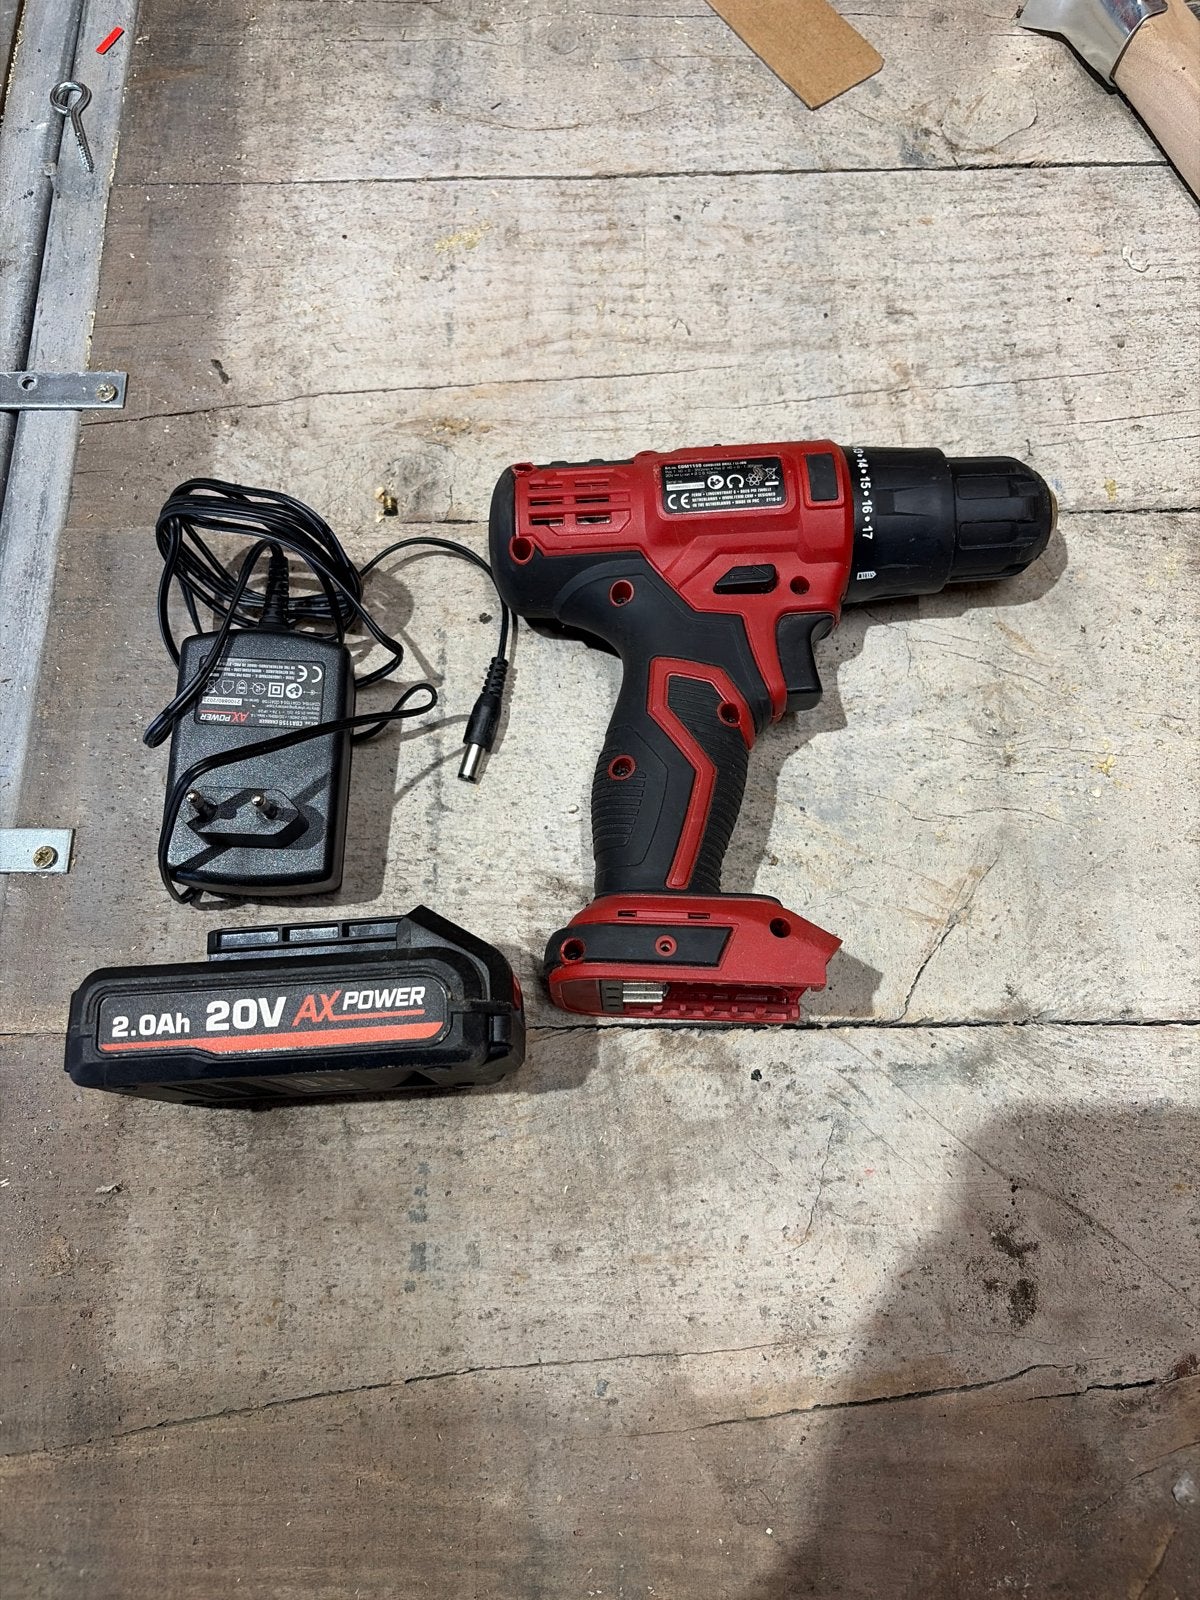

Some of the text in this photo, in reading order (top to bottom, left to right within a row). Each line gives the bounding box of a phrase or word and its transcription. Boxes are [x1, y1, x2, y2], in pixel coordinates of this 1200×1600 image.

[856, 458, 869, 468] 14
[860, 477, 871, 489] 15
[862, 500, 873, 513] 16
[862, 526, 873, 540] 17
[200, 713, 231, 722] POWER
[230, 711, 250, 722] AX
[112, 986, 426, 1038] 2.0Ah 20V AX POWER
